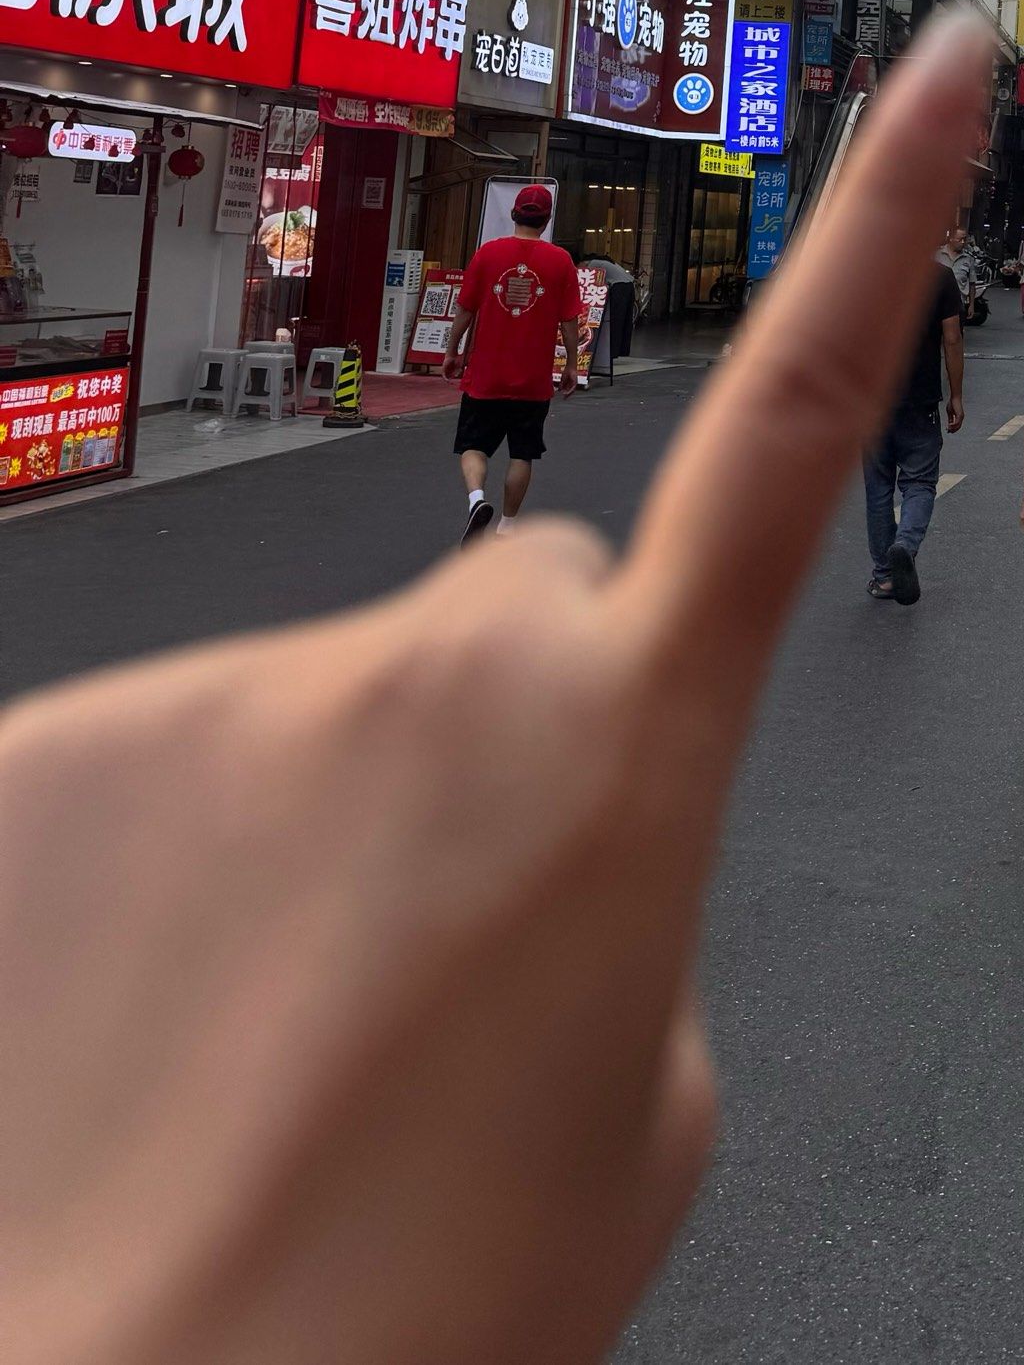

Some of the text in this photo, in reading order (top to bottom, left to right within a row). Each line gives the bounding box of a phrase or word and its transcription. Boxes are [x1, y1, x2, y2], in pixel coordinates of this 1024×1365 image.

[739, 2, 786, 20] 请上二楼
[637, 5, 665, 54] 宠物
[475, 29, 521, 78] 宠百道
[738, 26, 781, 132] 城市之家酒店
[230, 128, 262, 163] 招聘
[731, 135, 780, 148] 一楼向前5米
[757, 171, 785, 187] 宠物
[756, 192, 785, 208] 诊所
[757, 241, 776, 251] 扶梯
[77, 374, 123, 399] 祝您中奖
[57, 403, 122, 432] 最高可中100万
